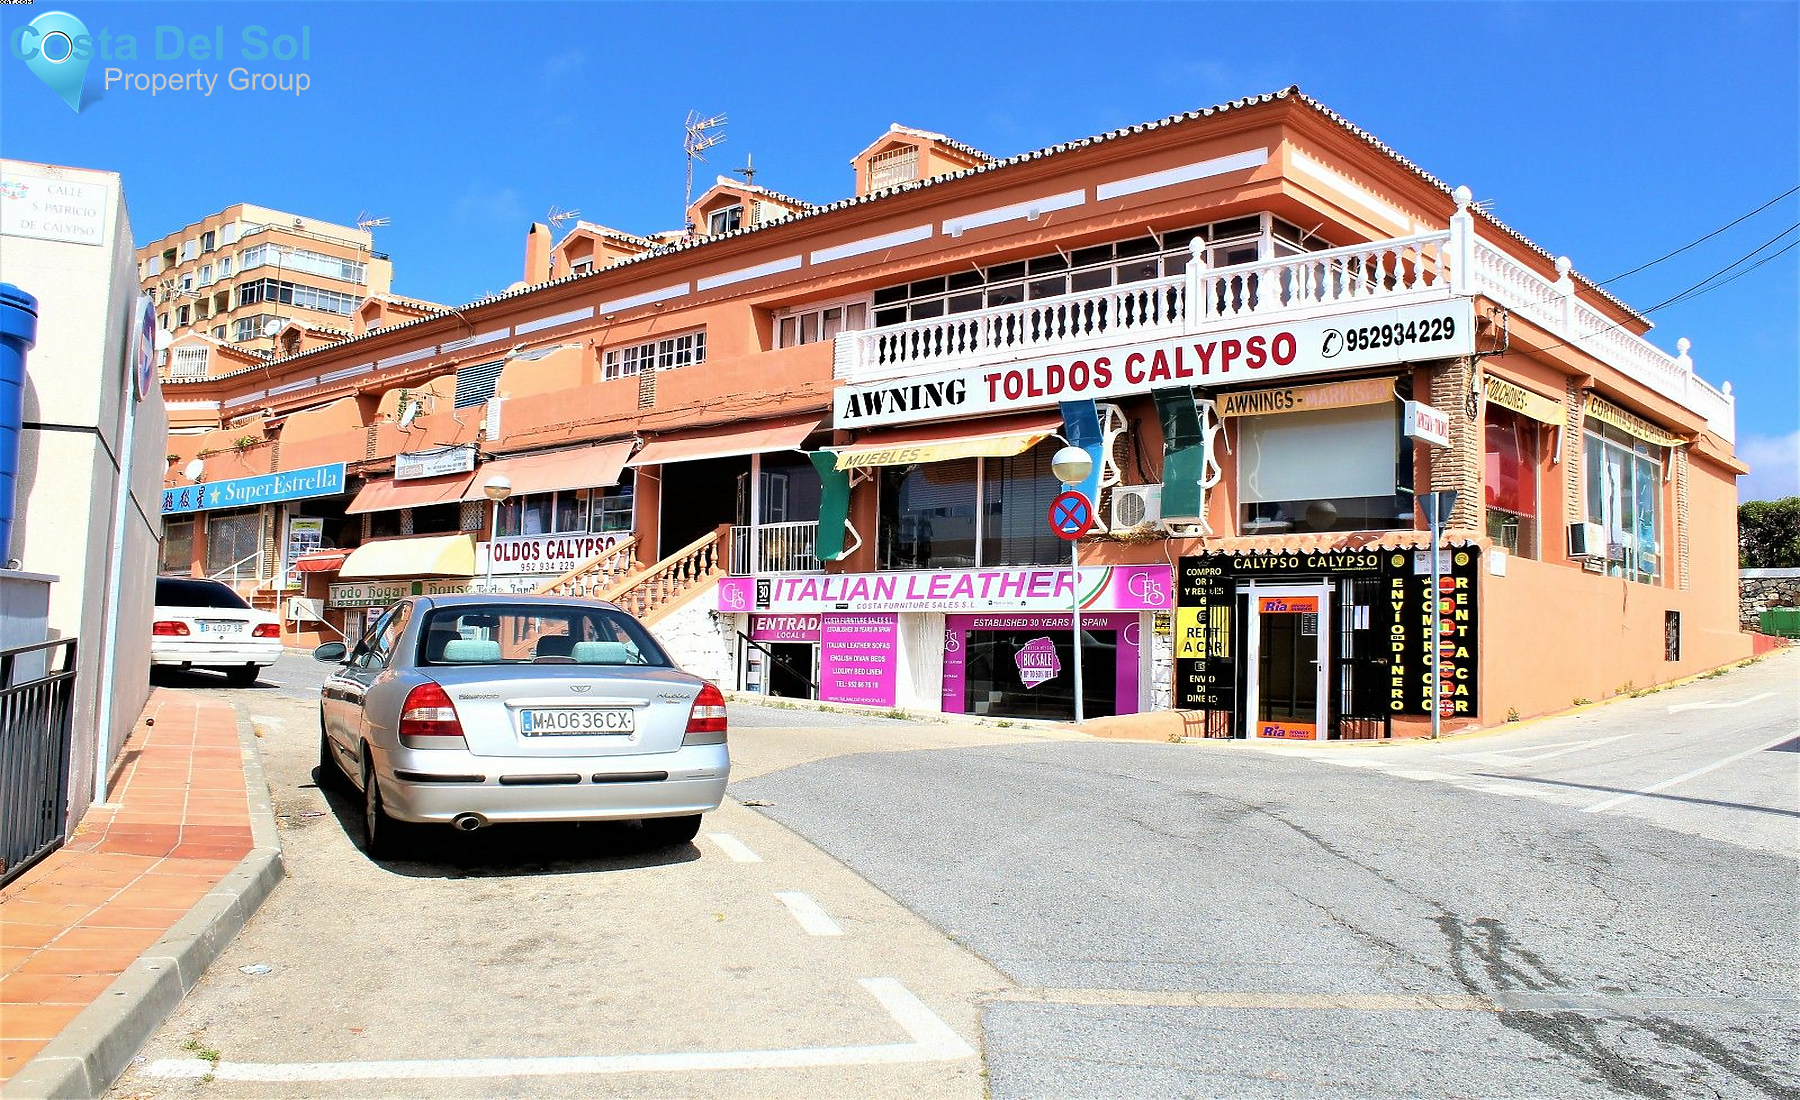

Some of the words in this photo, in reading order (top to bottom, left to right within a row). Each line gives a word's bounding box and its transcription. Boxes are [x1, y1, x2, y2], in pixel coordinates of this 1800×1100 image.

[48, 186, 83, 197] CALLE
[45, 202, 97, 217] PATRICIO
[21, 220, 35, 229] DE
[44, 223, 94, 236] CALYPSO
[843, 378, 966, 419] AWNING
[984, 357, 1113, 403] TOLDOS
[1124, 332, 1297, 385] CALYPSO
[1346, 316, 1455, 351] 952934229
[1225, 390, 1293, 414] AWNINGS
[845, 448, 921, 467] MUEBLES
[546, 537, 616, 559] CALYPSO
[521, 562, 535, 572] 952
[539, 562, 555, 571] 934
[559, 561, 575, 570] 229
[1234, 557, 1299, 569] CALYPSO
[1307, 555, 1378, 568] CALYPSO
[1186, 568, 1221, 576] COMPRO
[759, 586, 769, 598] 30
[774, 577, 897, 601] ITALIAN
[906, 571, 1082, 601] LEATHER
[931, 601, 960, 609] SALES
[1265, 599, 1288, 611] Ria
[1455, 577, 1469, 637] RENT
[213, 624, 231, 632] 4037
[757, 617, 820, 631] ENTRAD
[973, 619, 1028, 627] ESTABLISHED
[1029, 619, 1039, 627] 30
[1041, 619, 1069, 627] YEARS
[1081, 618, 1107, 627] SPAIN
[1184, 642, 1192, 652] A
[1455, 647, 1469, 658] A
[1024, 654, 1034, 666] BIG
[1036, 654, 1051, 666] SALE
[1190, 675, 1215, 683] ENVO
[1390, 642, 1404, 710] DINERO
[1454, 668, 1469, 712] CAR
[1263, 724, 1285, 737] Ria
